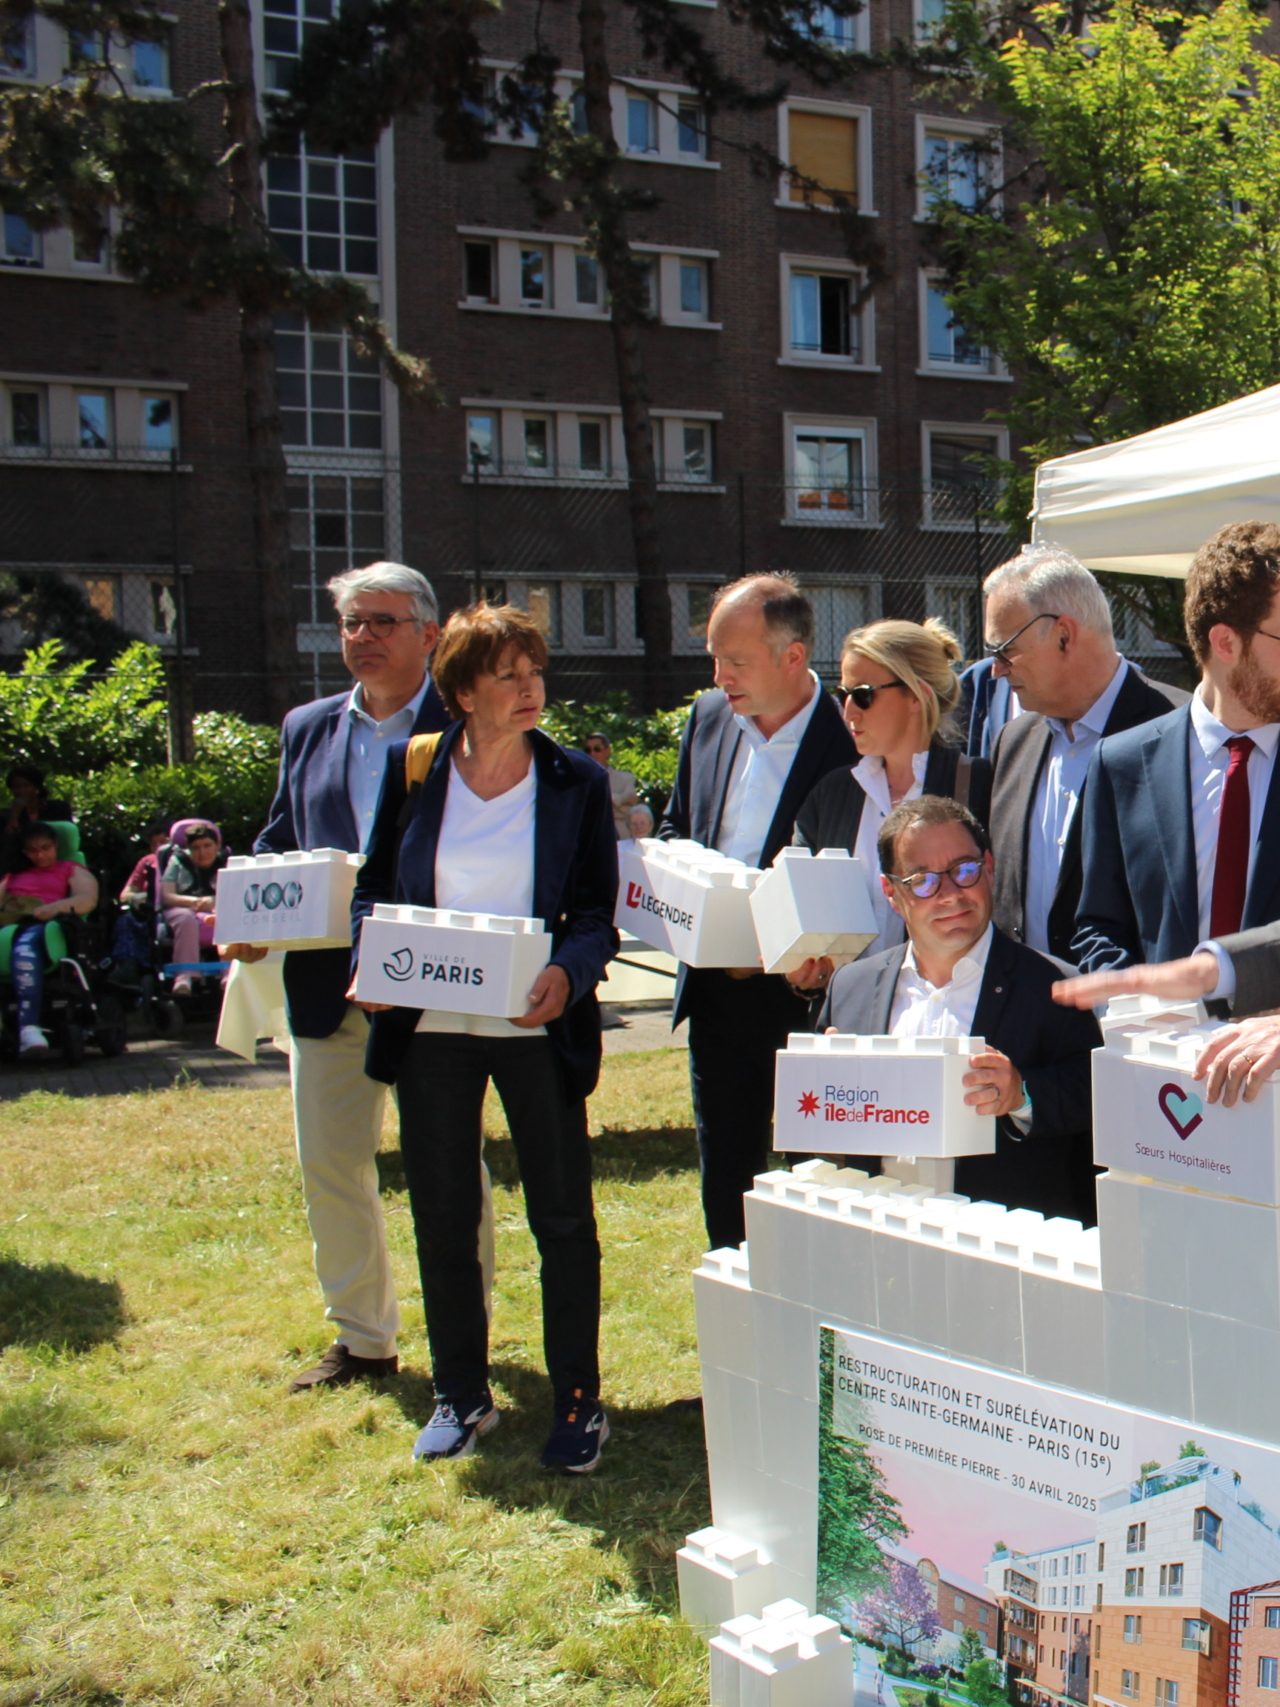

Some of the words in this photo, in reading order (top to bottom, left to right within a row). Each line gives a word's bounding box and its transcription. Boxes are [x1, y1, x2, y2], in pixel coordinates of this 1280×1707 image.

[641, 893, 694, 931] LEGENDRE
[421, 962, 484, 986] PARIS
[423, 953, 449, 962] VILLE
[453, 956, 465, 964] DE
[825, 1085, 879, 1105] Région
[1135, 1142, 1165, 1160] Sœurs
[1168, 1150, 1232, 1175] Hospitalières
[838, 1354, 961, 1404] RESTRUCTURATION
[966, 1392, 982, 1410] ET
[986, 1398, 1094, 1443] SURÉLÉVATION
[1100, 1431, 1120, 1450] DU
[838, 1376, 886, 1404] CENTRE
[890, 1392, 1014, 1443] SAINTE-GERMAINE
[1028, 1434, 1070, 1460] PARIS
[859, 1424, 886, 1443] POSE
[888, 1433, 901, 1449] DE
[904, 1439, 958, 1467] PREMIÈRE
[961, 1457, 1001, 1481] PIERRE
[1011, 1473, 1025, 1489] 30
[1028, 1480, 1063, 1502] AVRIL
[1067, 1492, 1097, 1512] 2025
